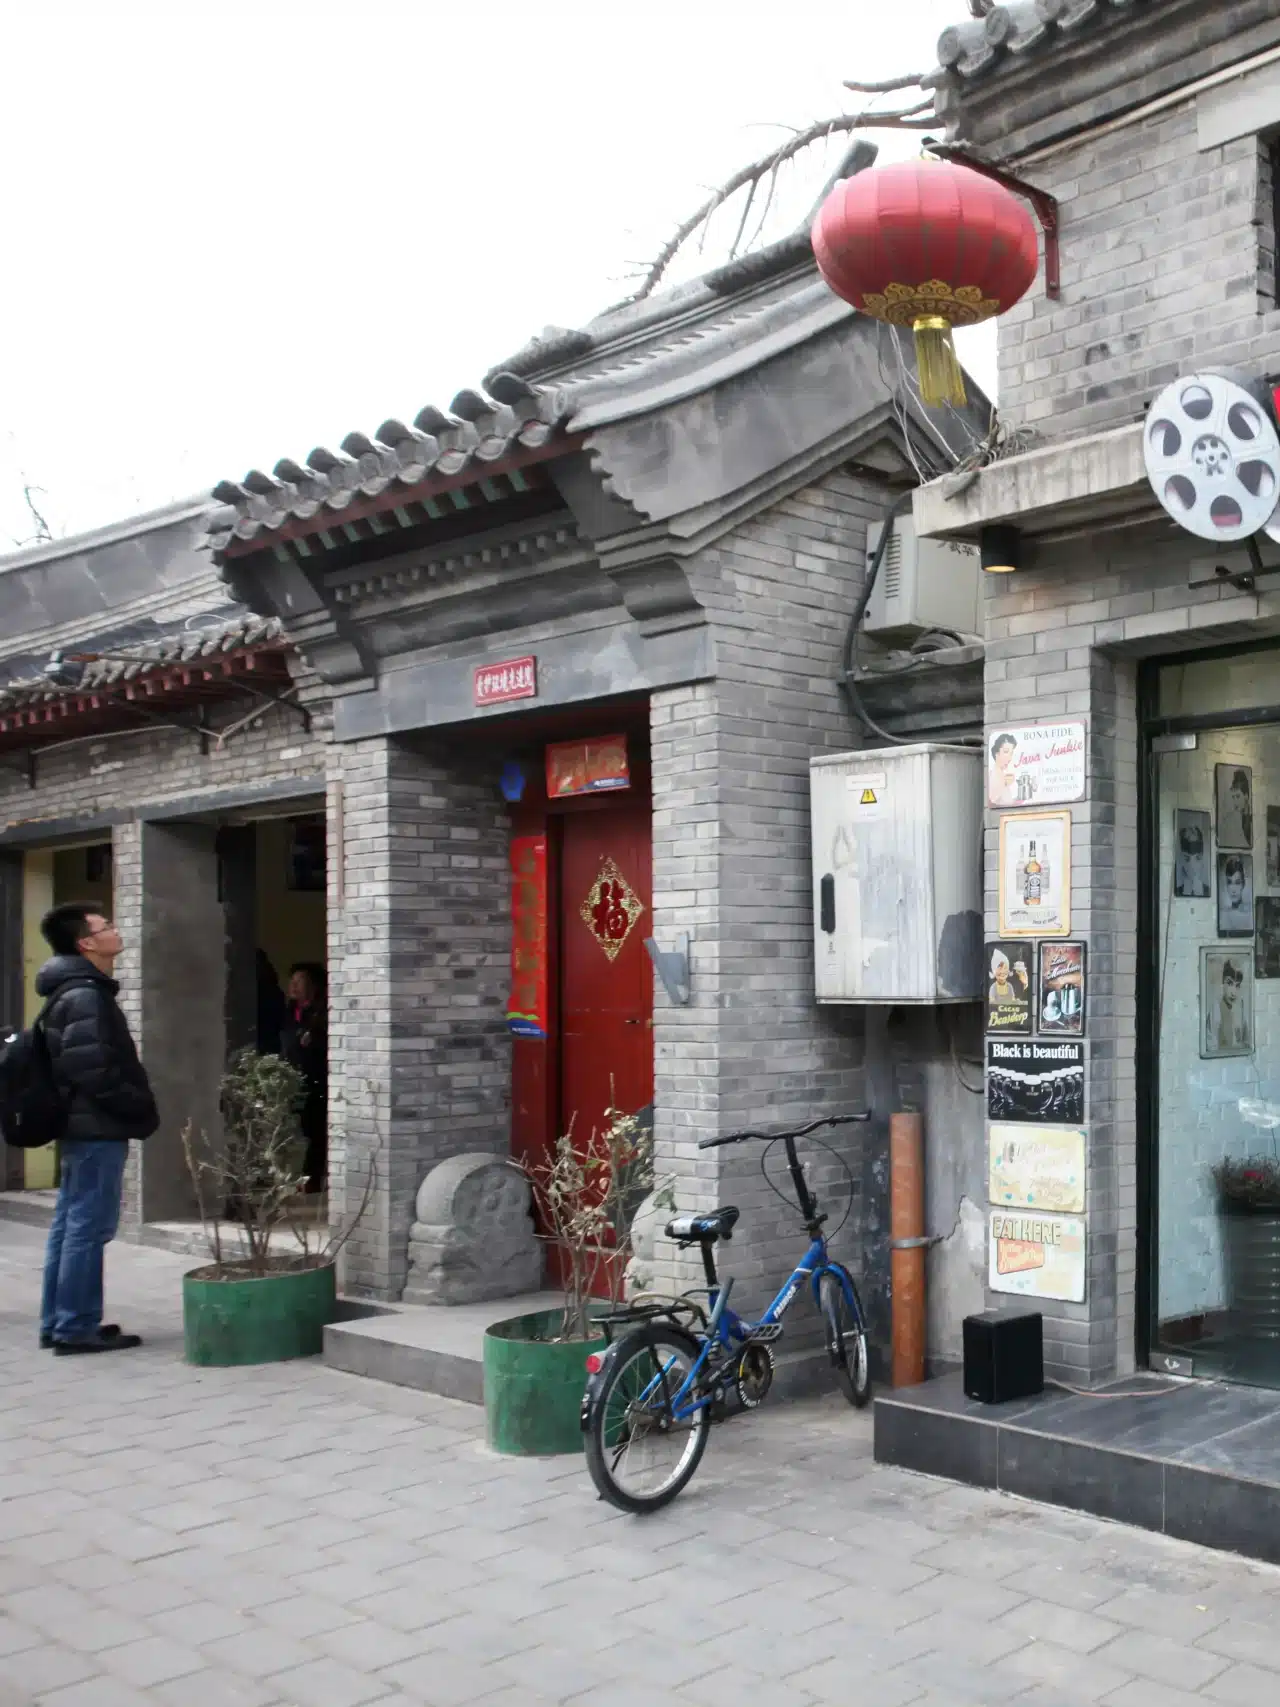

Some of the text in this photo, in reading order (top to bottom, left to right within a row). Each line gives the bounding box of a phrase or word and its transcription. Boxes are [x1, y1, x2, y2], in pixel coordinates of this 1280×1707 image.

[1023, 727, 1074, 741] BONA FIDE
[1013, 739, 1083, 768] Java Junkie
[992, 1043, 1079, 1060] Black is beautiful
[993, 1216, 1061, 1246] EAT HERE
